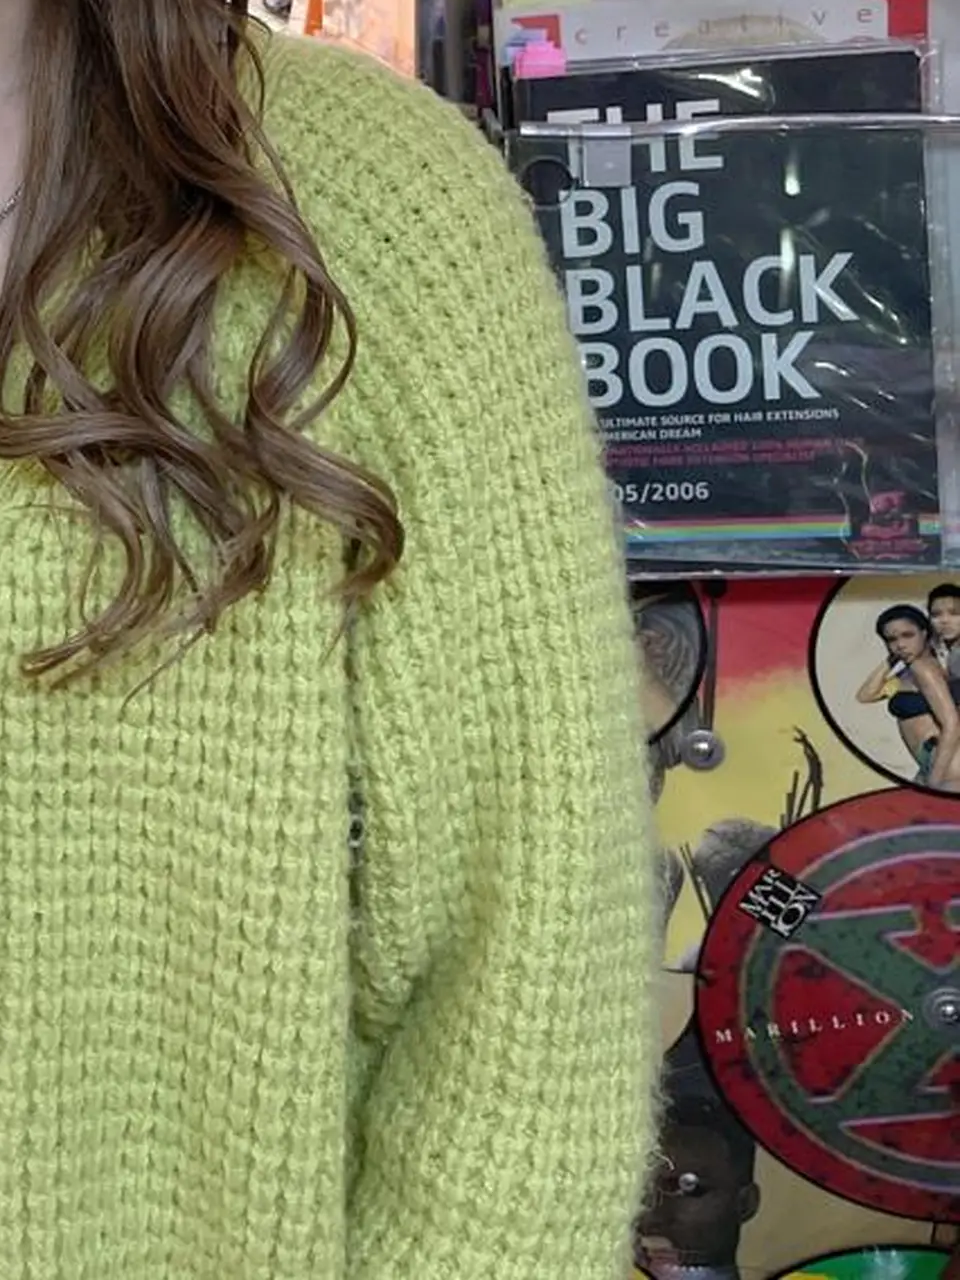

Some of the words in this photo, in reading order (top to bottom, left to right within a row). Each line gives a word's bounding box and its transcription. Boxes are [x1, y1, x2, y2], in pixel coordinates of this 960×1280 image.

[558, 180, 705, 259] BIG
[566, 252, 860, 336] BLACK
[583, 330, 822, 410] BOOK
[659, 427, 702, 439] DREAM
[660, 413, 705, 426] SOURCE
[708, 412, 731, 424] FOR
[734, 410, 763, 422] HAIR
[766, 407, 840, 422] EXTENSIONS
[715, 1007, 916, 1044] MARILLION
